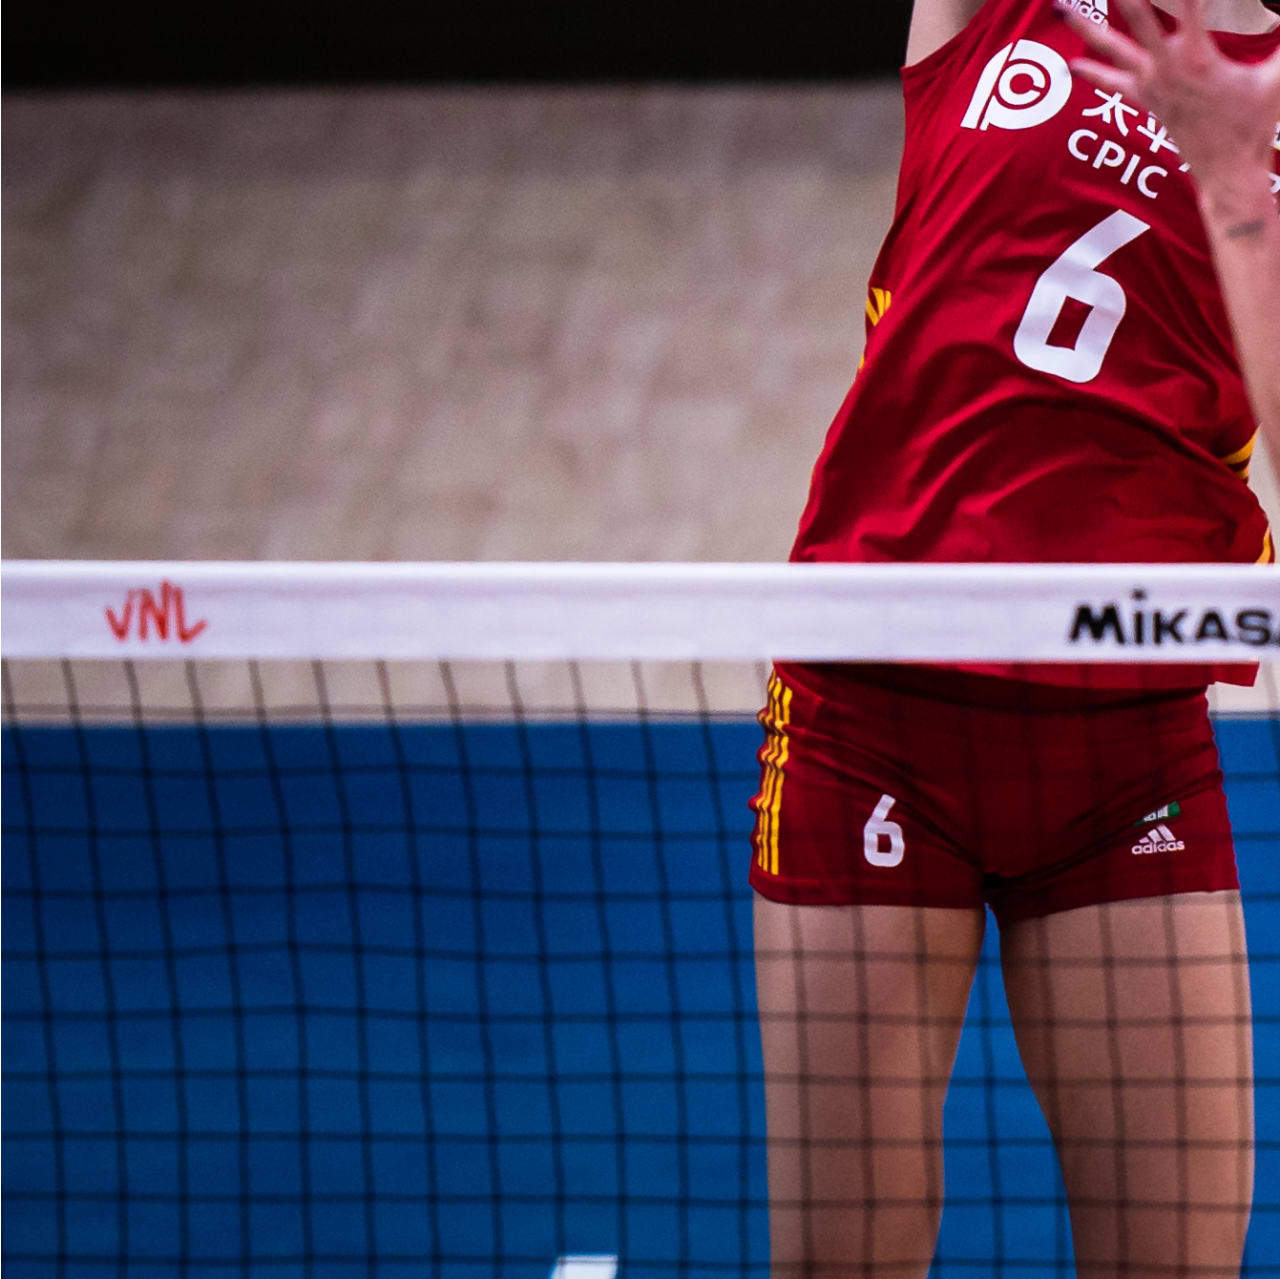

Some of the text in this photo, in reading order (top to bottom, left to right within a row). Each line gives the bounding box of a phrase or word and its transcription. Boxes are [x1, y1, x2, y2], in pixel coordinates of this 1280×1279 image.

[1067, 128, 1168, 199] CPIC
[1012, 208, 1151, 384] 6
[104, 579, 208, 644] VNL
[863, 794, 905, 867] 6
[1131, 840, 1185, 855] adidas
